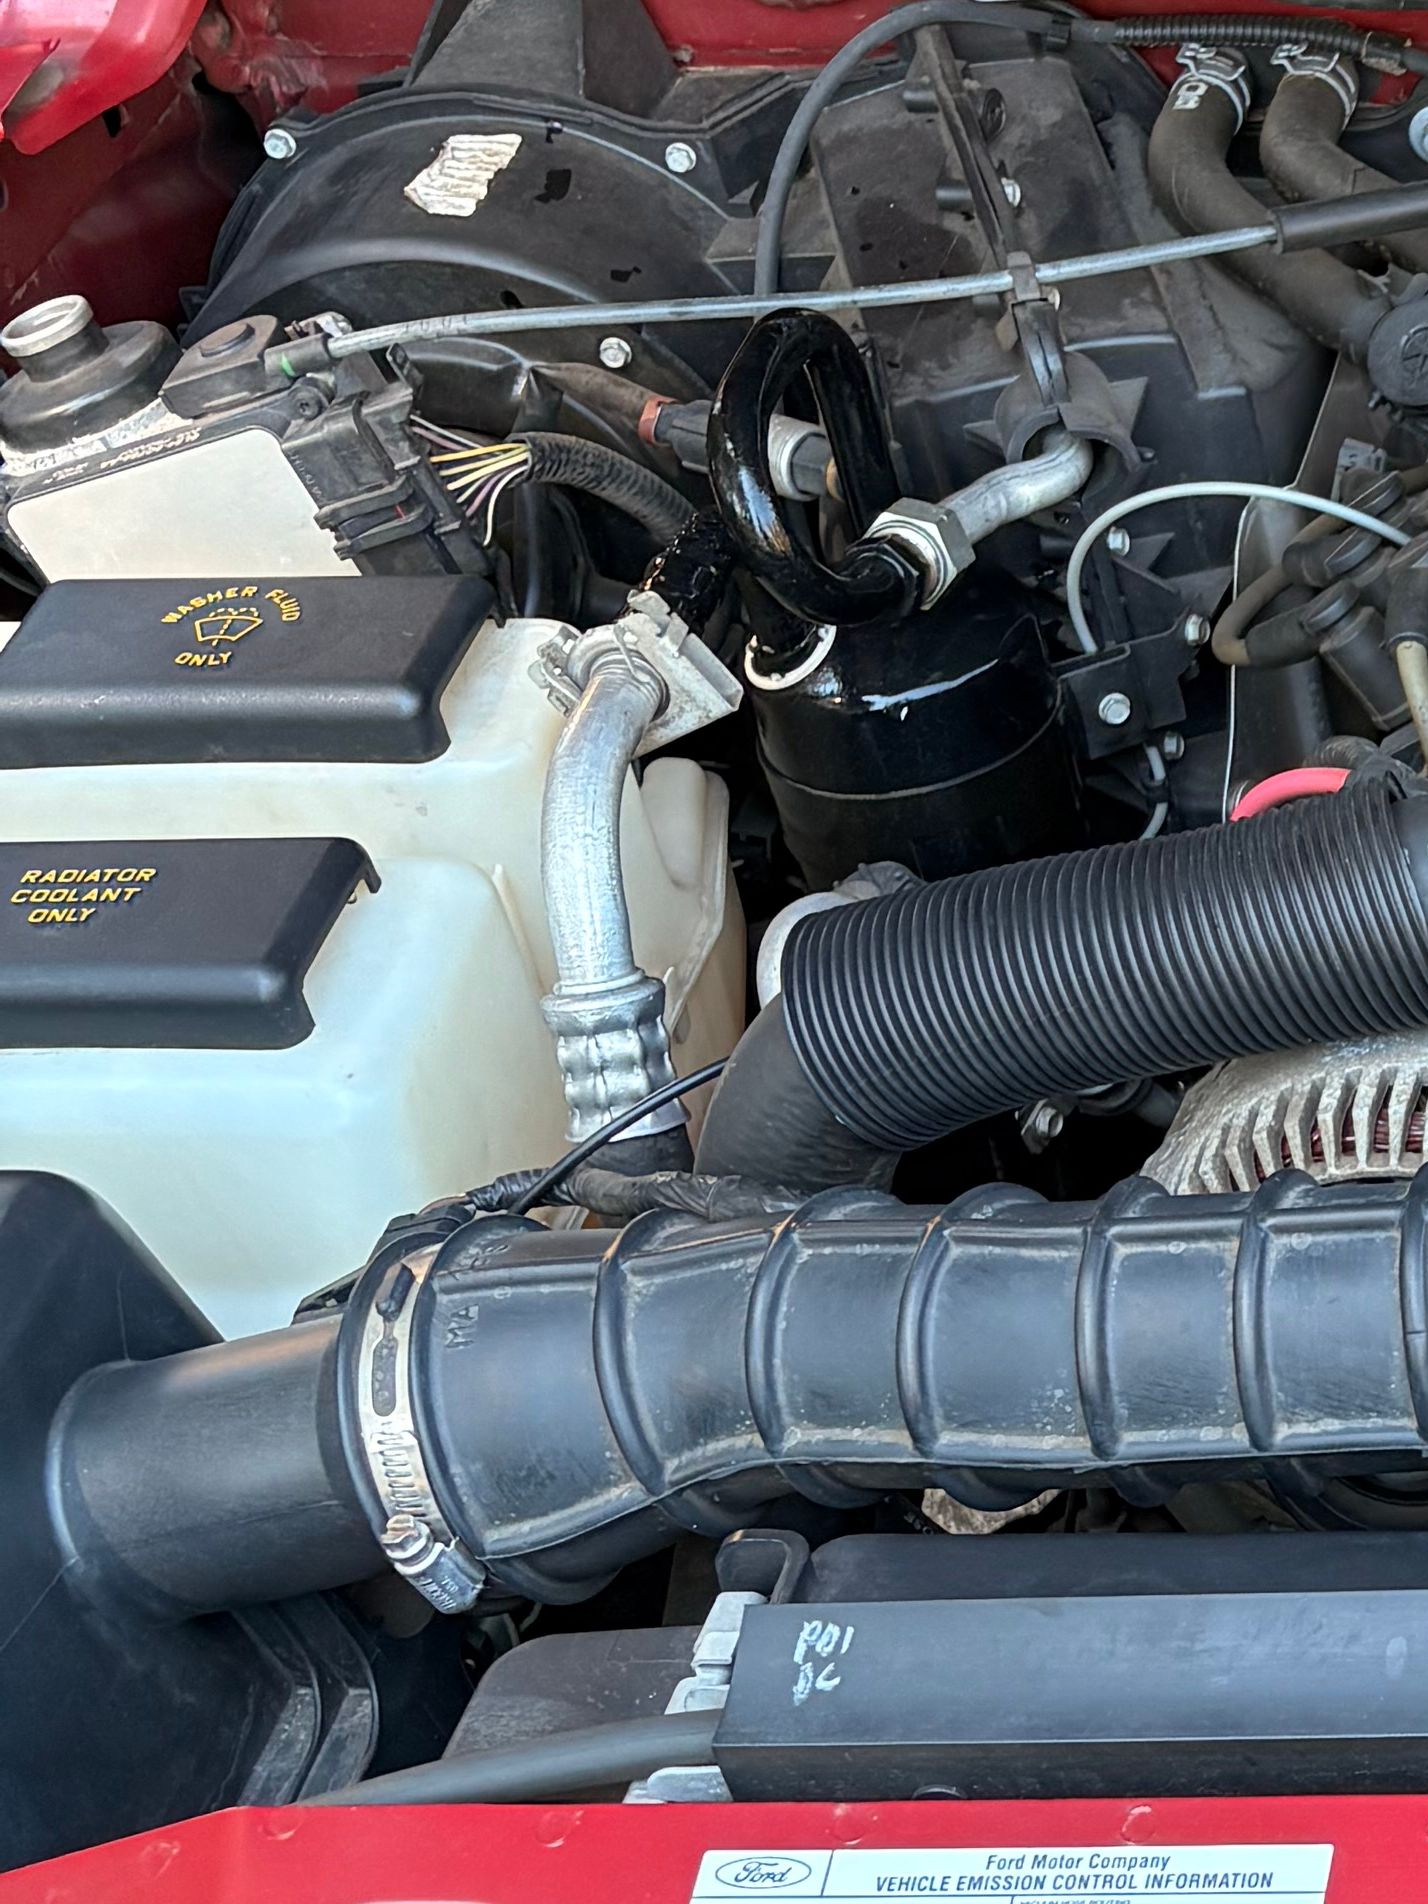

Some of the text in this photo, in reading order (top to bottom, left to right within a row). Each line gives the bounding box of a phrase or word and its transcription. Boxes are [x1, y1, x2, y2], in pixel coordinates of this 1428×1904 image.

[161, 586, 301, 623] WASHER FLUID
[175, 652, 232, 666] ONLY
[20, 868, 156, 883] RADIATOR
[11, 888, 141, 903] COOLANT
[28, 908, 96, 923] ONLY
[985, 1853, 1170, 1871] Ford Motor Company
[734, 1861, 791, 1884] Ford
[876, 1872, 1273, 1892] VEHICLE EMISSION CONTROL INFORMATION
